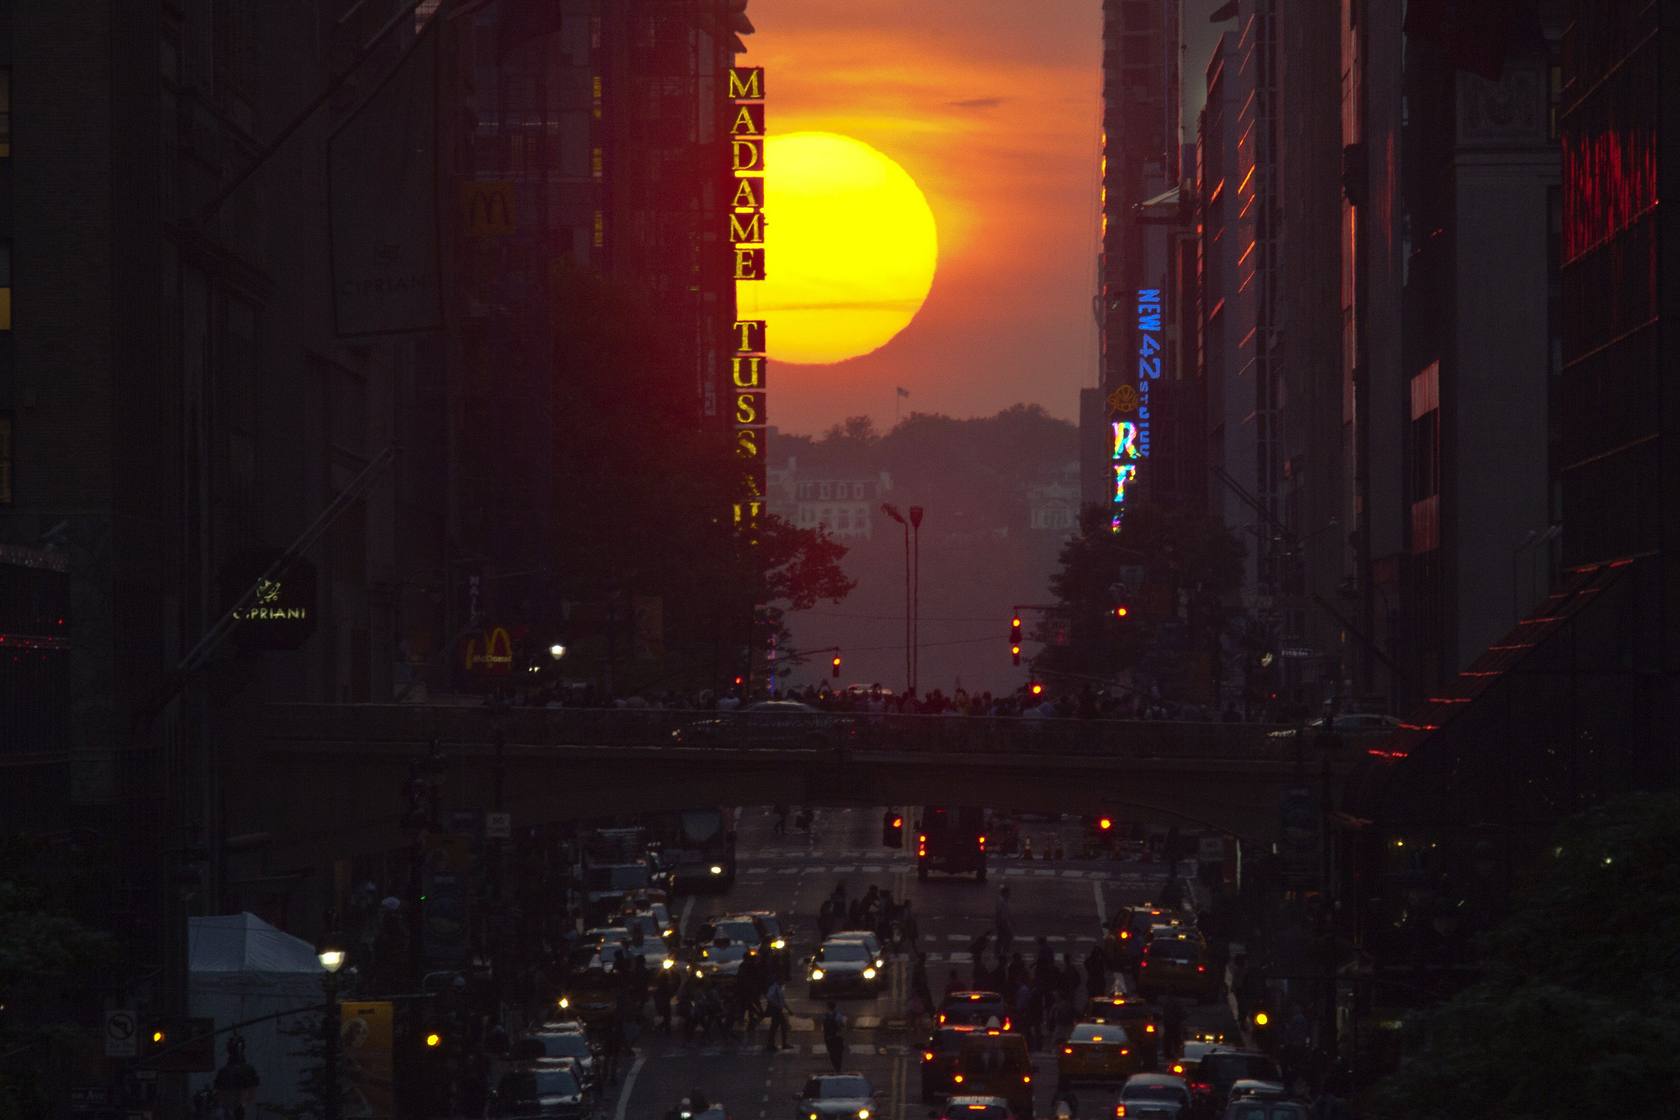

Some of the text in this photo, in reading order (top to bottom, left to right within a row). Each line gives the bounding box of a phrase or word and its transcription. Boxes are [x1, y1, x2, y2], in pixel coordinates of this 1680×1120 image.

[728, 69, 762, 279] MADAME
[1137, 288, 1161, 332] NEW
[1138, 333, 1161, 380] 42
